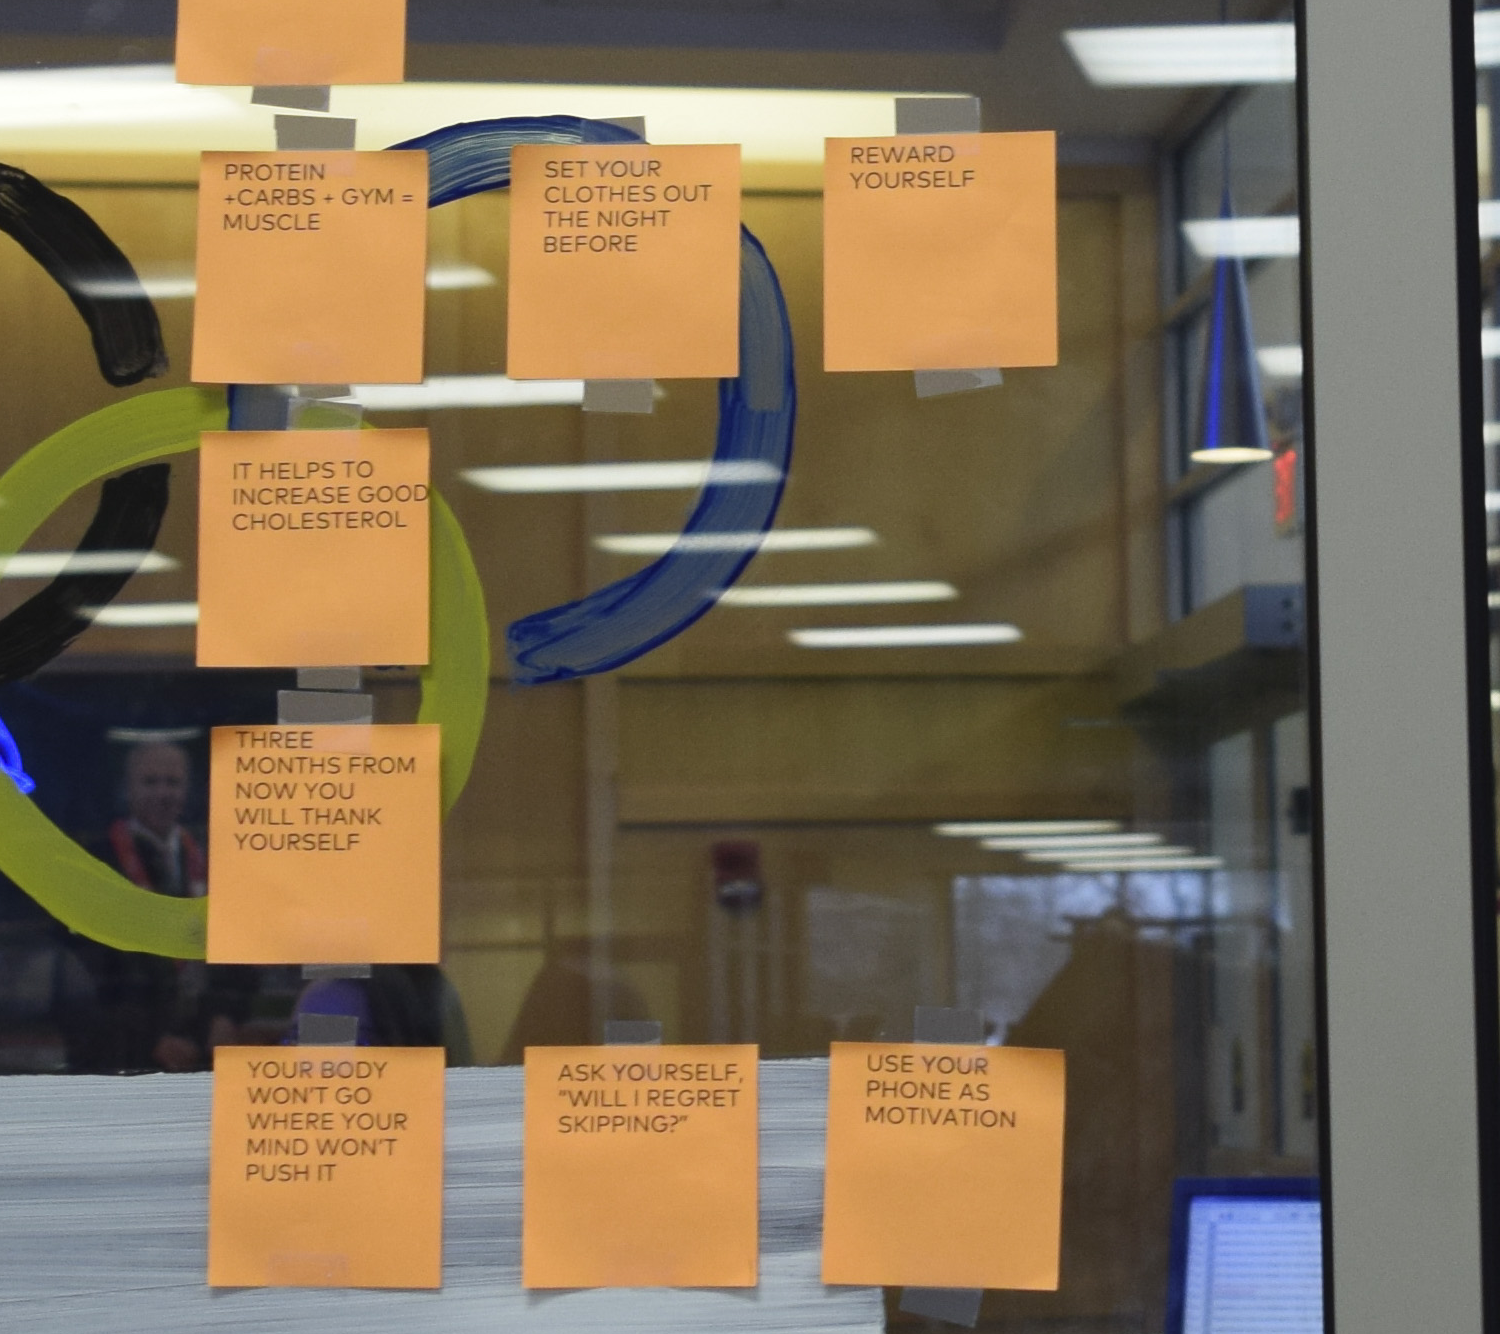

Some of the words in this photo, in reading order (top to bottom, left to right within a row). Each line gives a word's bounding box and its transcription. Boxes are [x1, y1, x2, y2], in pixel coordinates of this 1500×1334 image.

[850, 144, 956, 165] REWARD
[544, 160, 590, 179] SET
[595, 159, 662, 178] YOUR
[849, 169, 976, 190] YOURSELF
[543, 184, 657, 204] CLOTHES
[662, 183, 713, 203] OUT
[542, 209, 590, 229] THE
[597, 209, 672, 228] NIGHT
[543, 234, 638, 254] BEFORE
[235, 730, 314, 750] THREE
[236, 756, 342, 775] MONTHS
[348, 755, 416, 775] FROM
[235, 781, 298, 801] NOW
[304, 781, 355, 801] YOU
[234, 807, 295, 826] WILL
[299, 807, 382, 826] THANK
[234, 832, 360, 852] YOURSELF
[866, 1053, 914, 1074] USE
[921, 1055, 989, 1076] YOUR
[865, 1079, 952, 1101] PHONE
[958, 1082, 991, 1102] AS
[865, 1105, 1017, 1129] MOTIVATION
